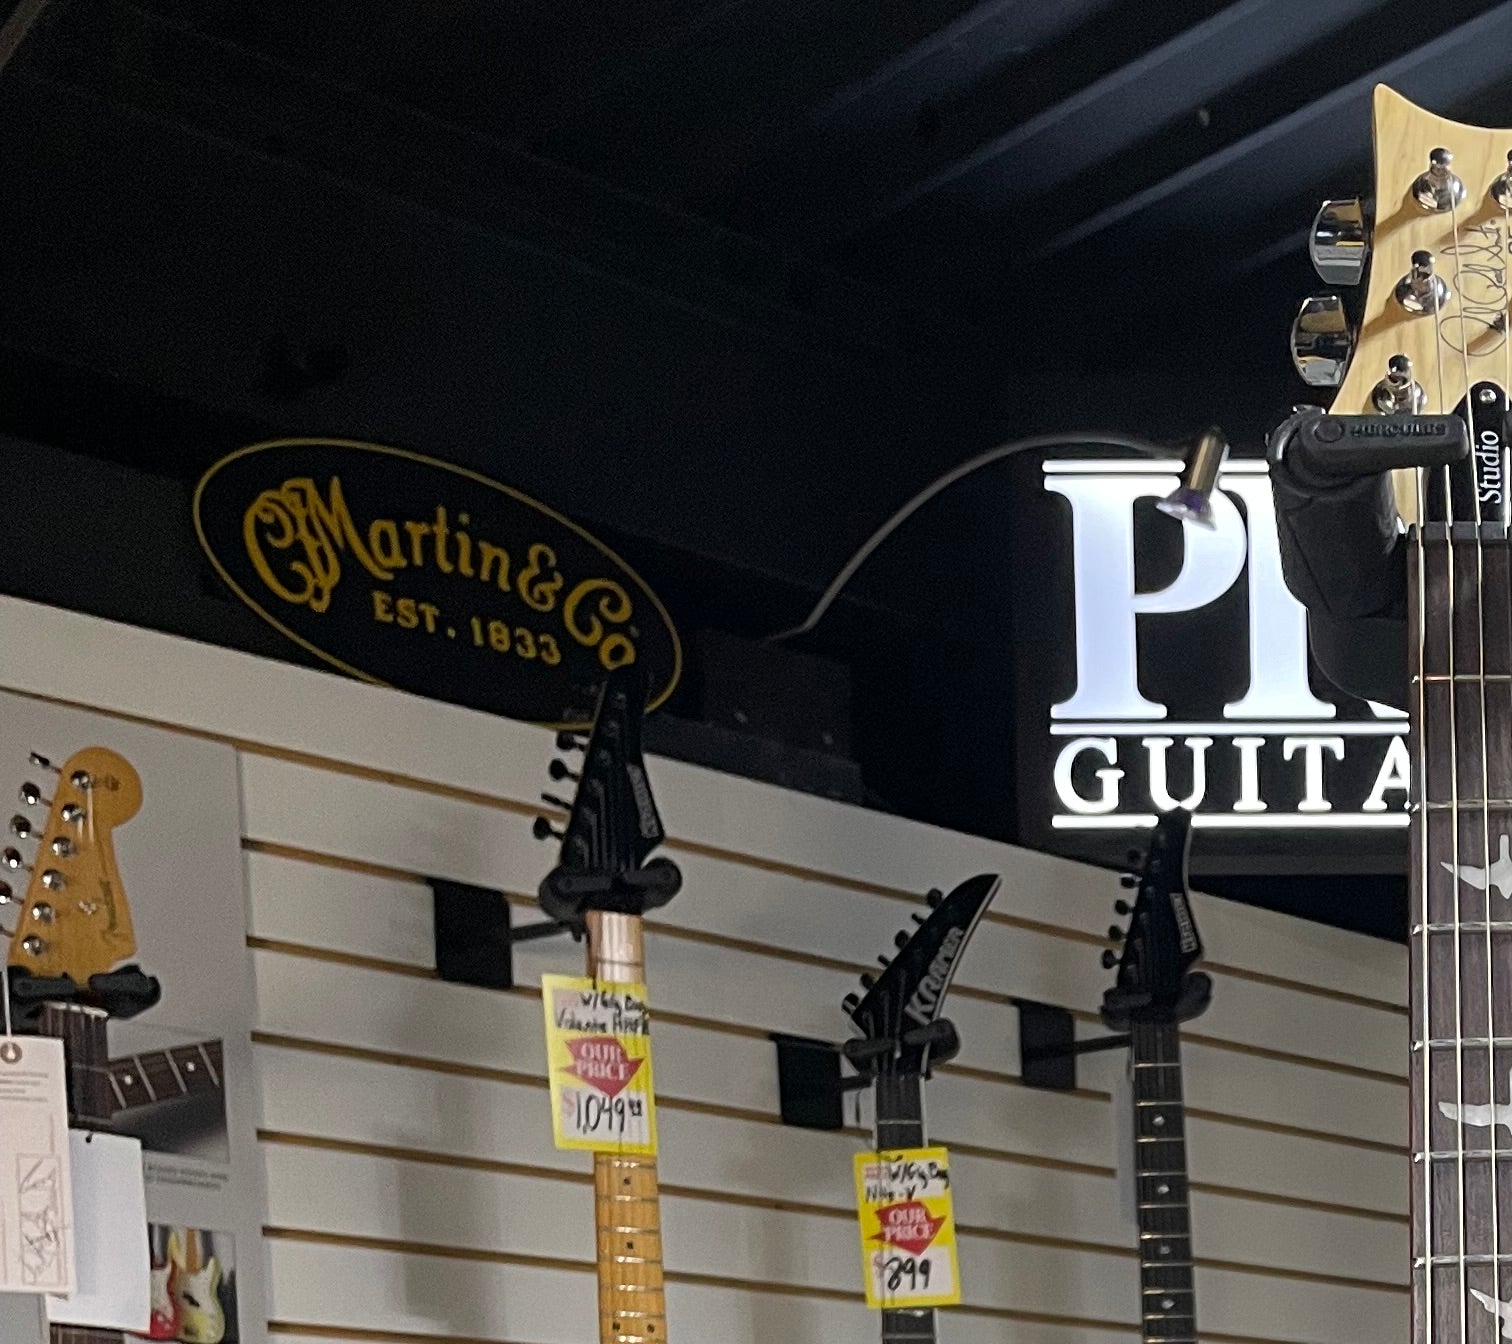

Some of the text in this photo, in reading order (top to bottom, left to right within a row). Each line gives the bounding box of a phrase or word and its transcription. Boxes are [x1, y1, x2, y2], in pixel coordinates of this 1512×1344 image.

[1475, 430, 1500, 503] Studio
[470, 616, 562, 666] 1833
[1053, 736, 1411, 814] GUITA
[581, 1041, 623, 1062] OUR
[575, 1060, 629, 1082] PRICE
[888, 1207, 928, 1226] OUR
[884, 1222, 935, 1243] PRICE
